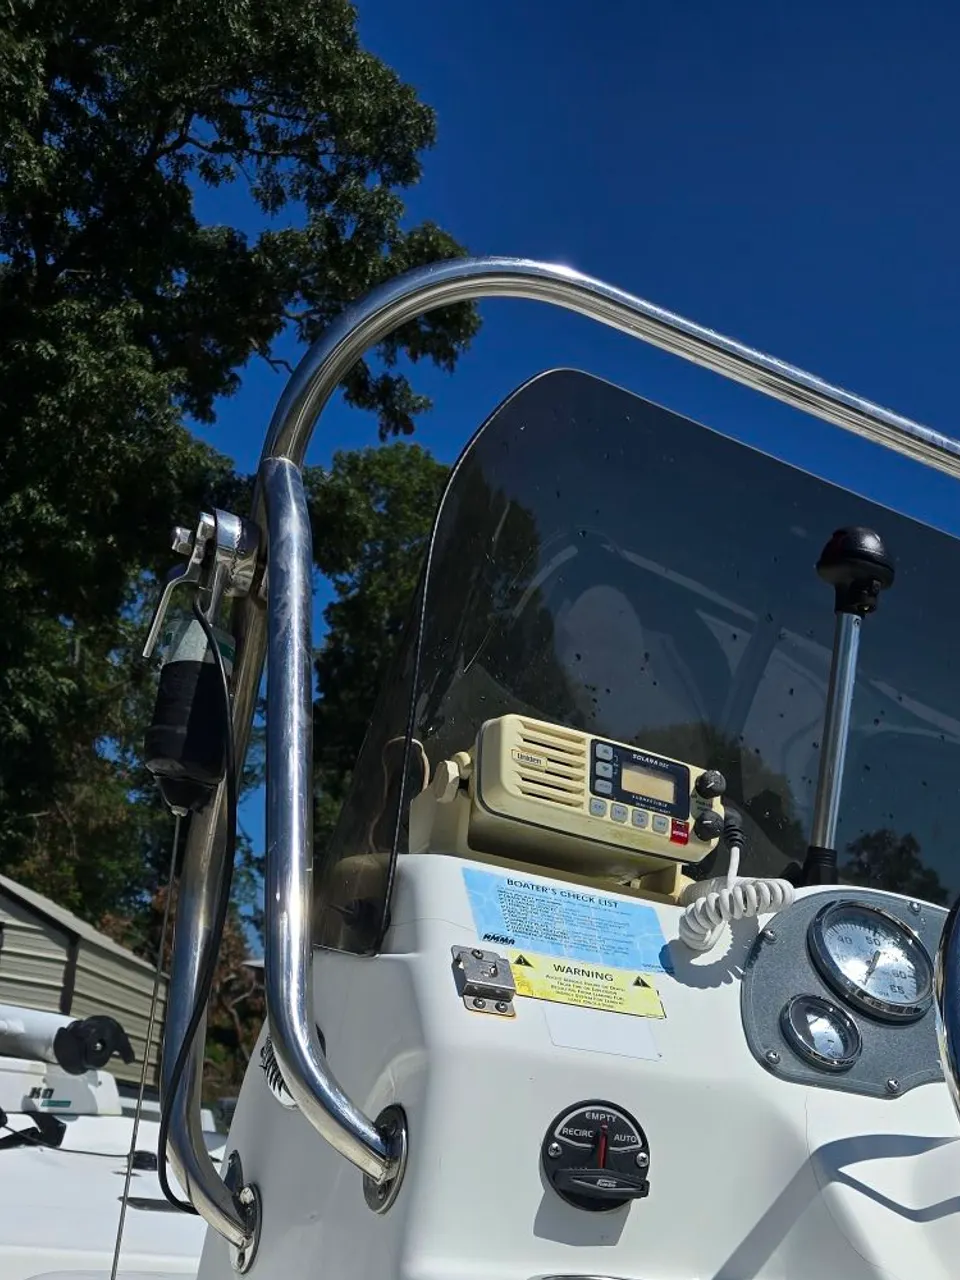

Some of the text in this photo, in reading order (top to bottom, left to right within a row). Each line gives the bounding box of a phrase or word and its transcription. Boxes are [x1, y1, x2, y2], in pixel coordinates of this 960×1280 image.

[507, 878, 619, 909] BOATER'S CHECK LIST
[865, 935, 880, 946] 50
[553, 963, 614, 982] WARNING
[889, 984, 905, 994] 65
[585, 1111, 617, 1123] EMPTY
[562, 1127, 594, 1138] RECIRC
[613, 1133, 637, 1143] AUTO
